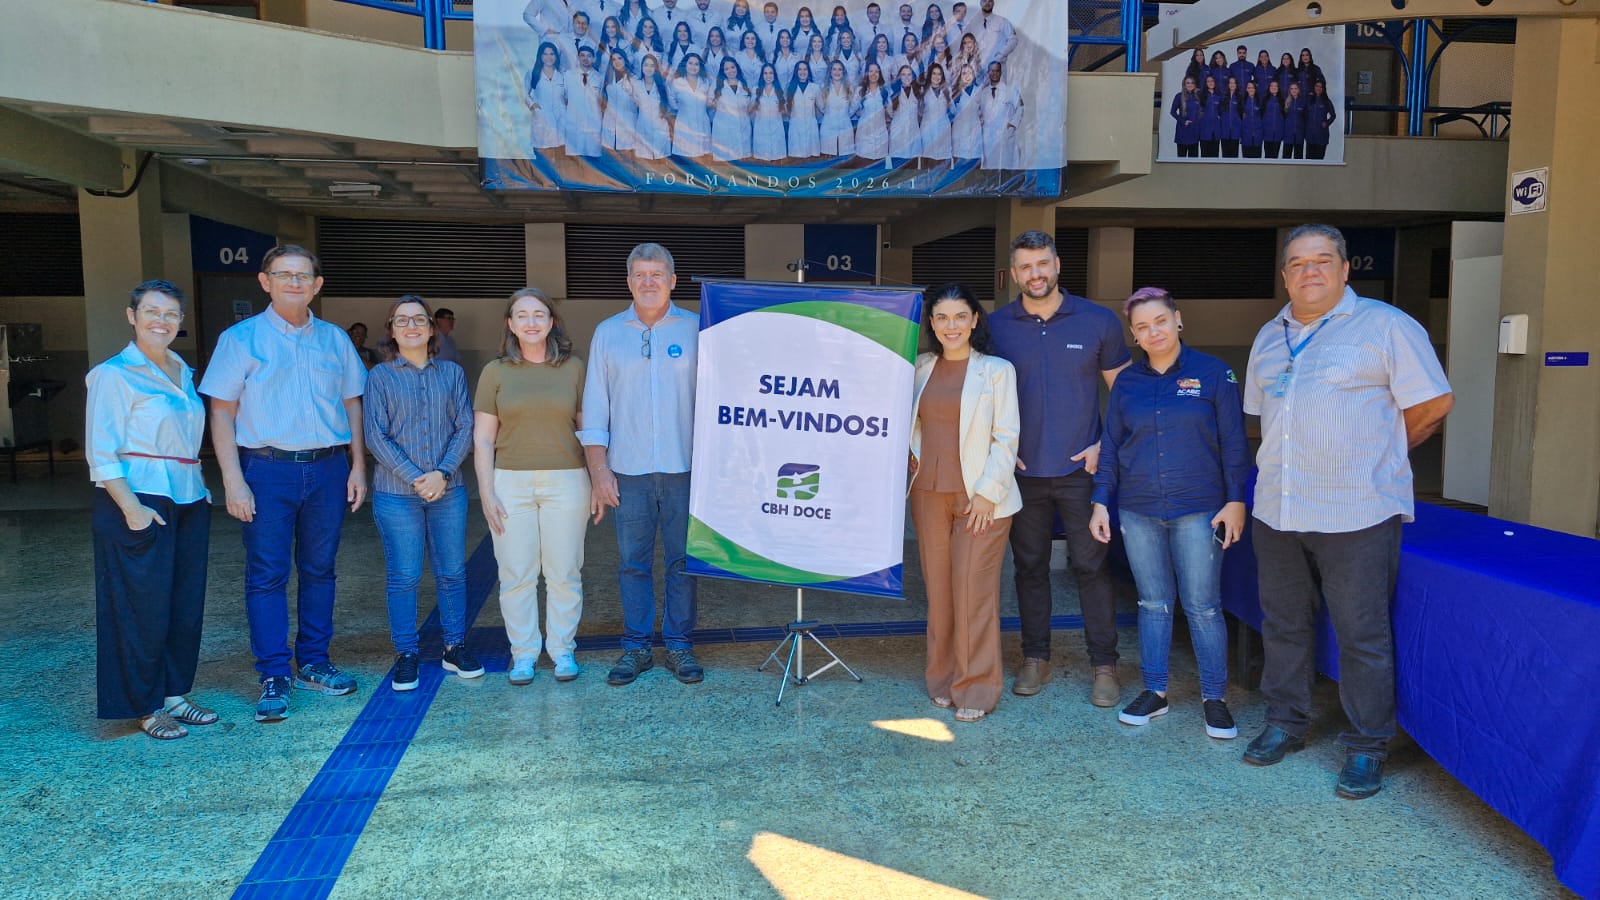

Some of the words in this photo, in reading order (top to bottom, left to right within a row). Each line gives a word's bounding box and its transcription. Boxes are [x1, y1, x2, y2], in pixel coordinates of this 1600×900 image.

[645, 172, 816, 189] FORMANDOS
[835, 177, 916, 190] 2026.1
[220, 247, 249, 265] 04
[826, 255, 852, 271] 03
[1351, 255, 1375, 271] 02
[758, 374, 841, 399] SEJAM
[717, 405, 889, 438] BEM-VINDOS!
[761, 502, 789, 516] CBH
[793, 505, 832, 520] DOCE
